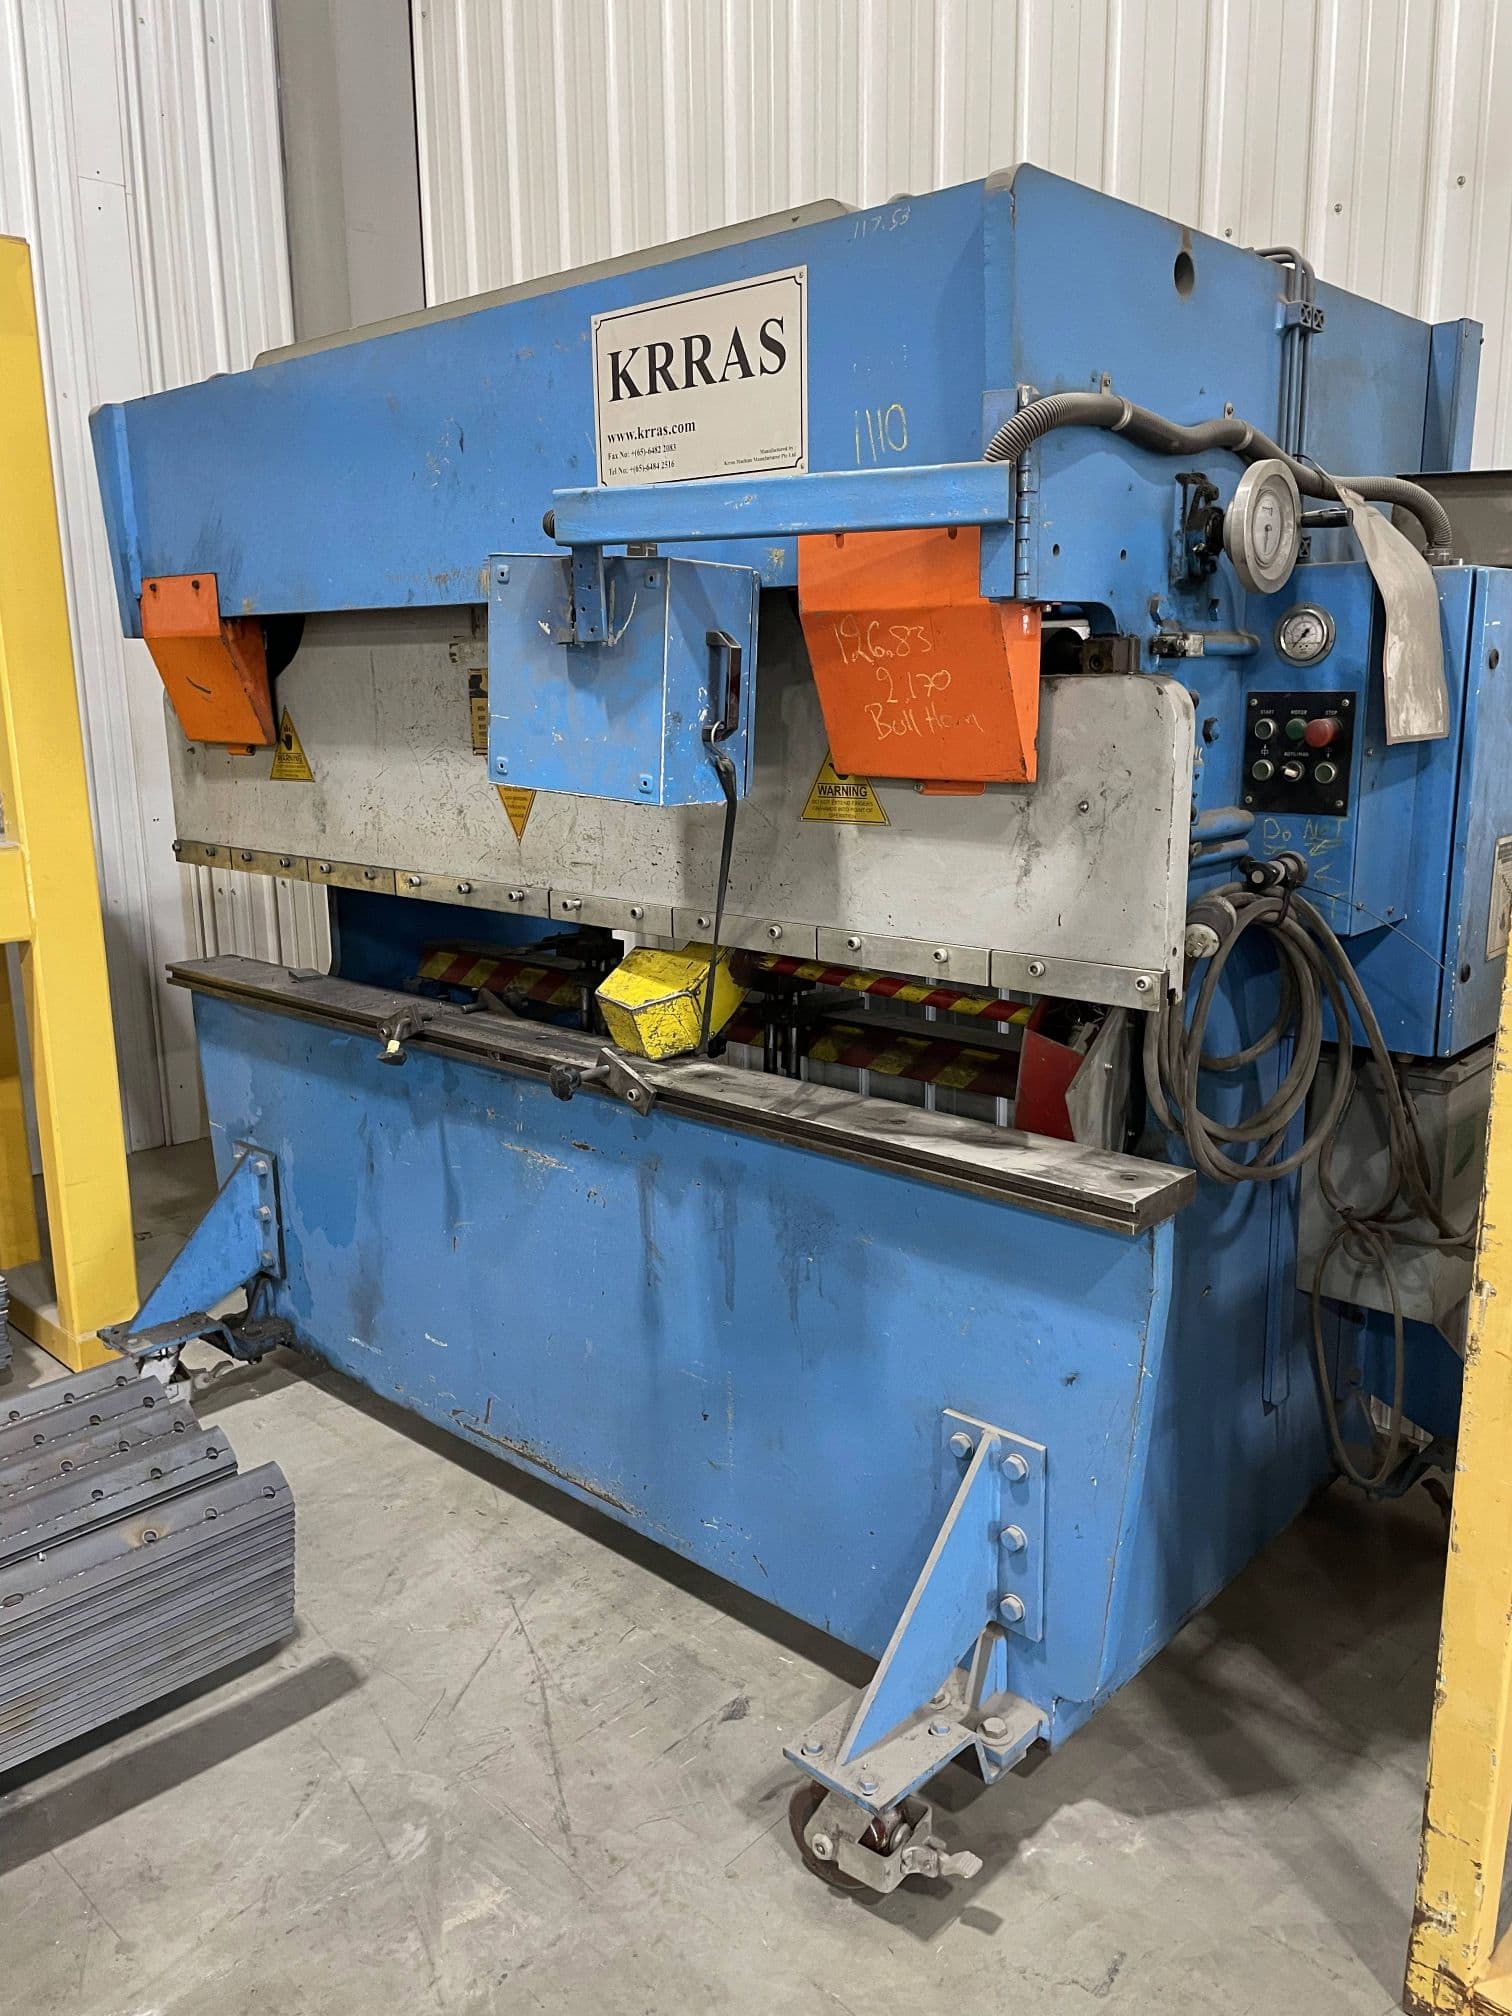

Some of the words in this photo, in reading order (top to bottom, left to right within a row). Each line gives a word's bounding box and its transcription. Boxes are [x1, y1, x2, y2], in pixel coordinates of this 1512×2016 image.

[607, 315, 787, 403] KRRAS
[607, 421, 696, 443] www.krras.com
[607, 452, 618, 460] Fax
[609, 467, 617, 476] Tel
[661, 460, 675, 470] 2516
[817, 785, 867, 797] WARNING
